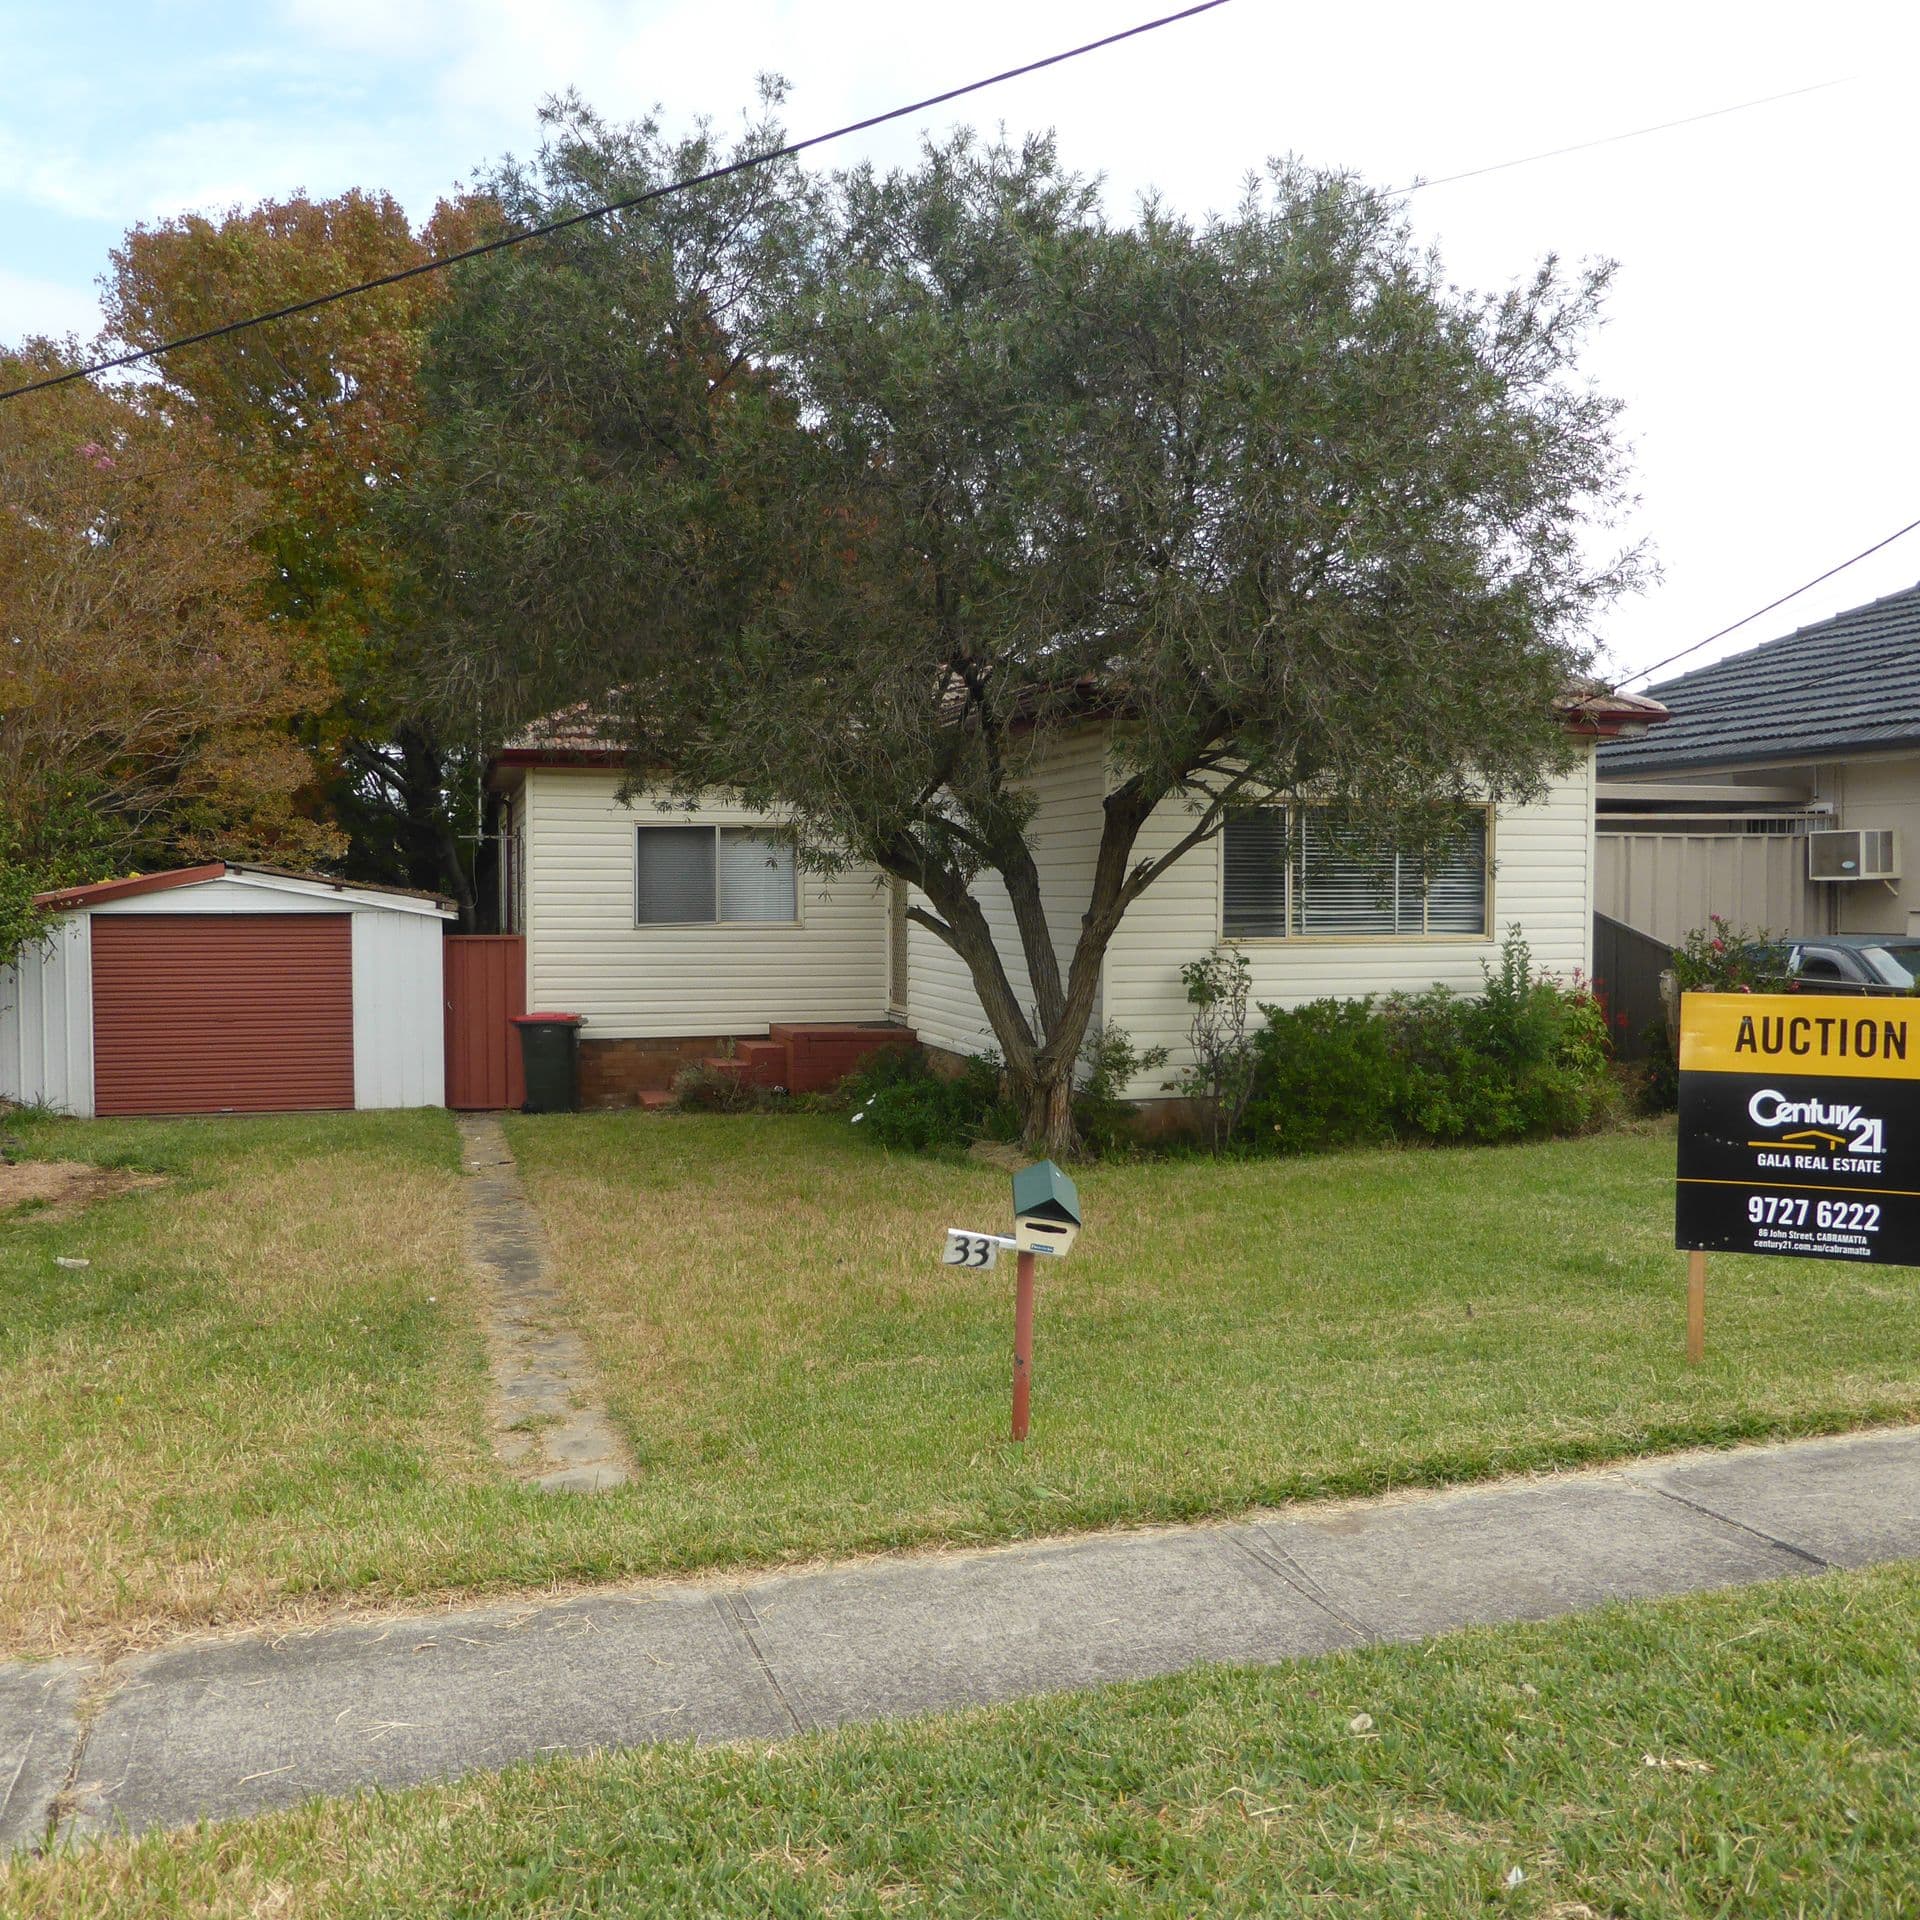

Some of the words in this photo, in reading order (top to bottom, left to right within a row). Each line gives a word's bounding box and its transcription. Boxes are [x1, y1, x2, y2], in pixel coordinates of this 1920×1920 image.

[1734, 1015, 1908, 1060] AUCTION
[1748, 1089, 1862, 1130] Century
[1848, 1117, 1883, 1153] 21
[1757, 1153, 1791, 1168] GALA
[1795, 1155, 1829, 1170] REAL
[1833, 1157, 1882, 1174] ESTATE
[1748, 1196, 1809, 1226] 9727
[1816, 1200, 1880, 1232] 6222
[947, 1235, 990, 1267] 33
[1753, 1239, 1871, 1256] century21.com.au/cabramatta
[1769, 1229, 1787, 1239] John
[1788, 1230, 1815, 1241] Street,
[1816, 1232, 1867, 1245] CABRAMATTA
